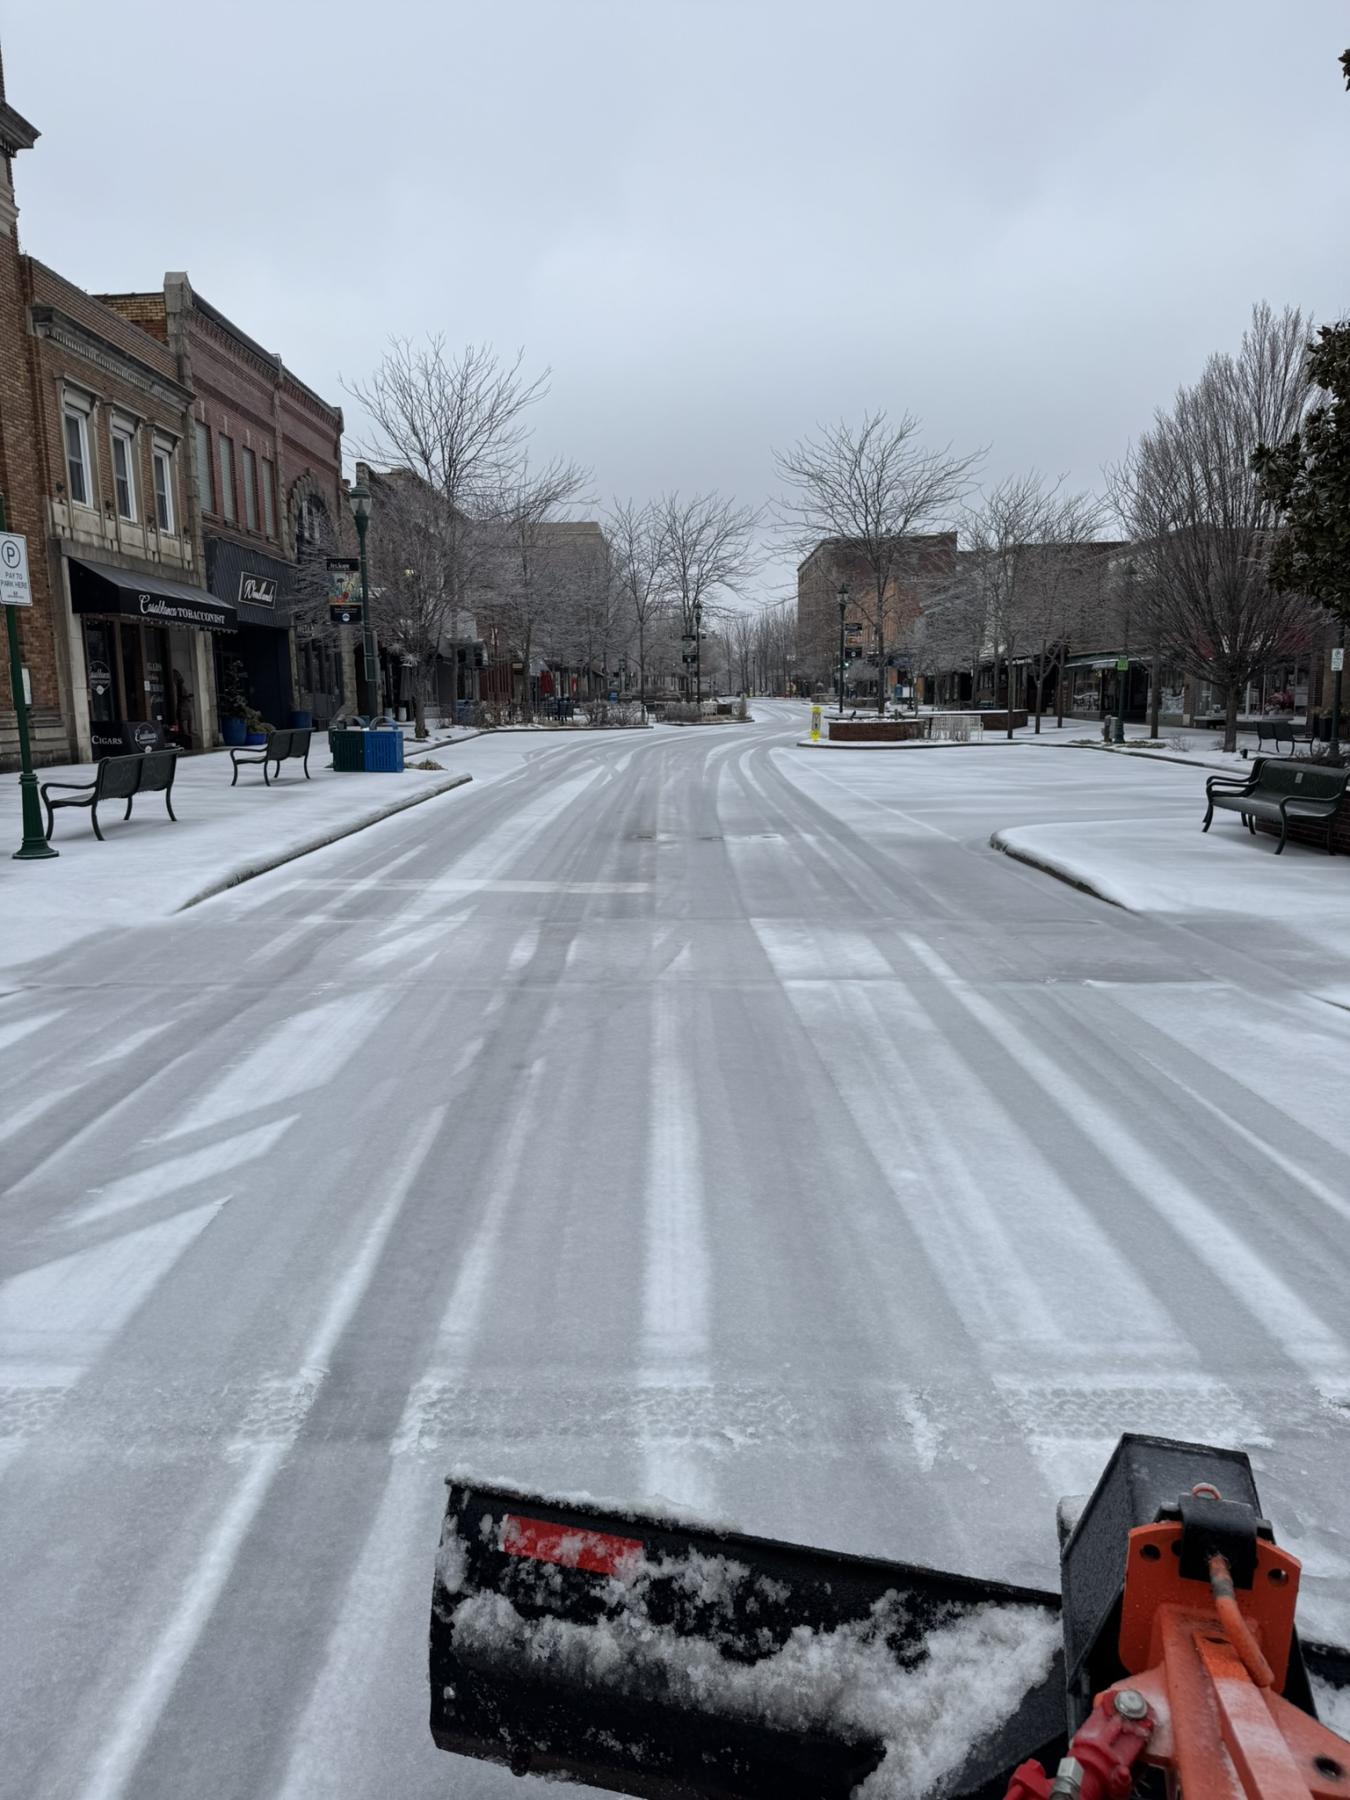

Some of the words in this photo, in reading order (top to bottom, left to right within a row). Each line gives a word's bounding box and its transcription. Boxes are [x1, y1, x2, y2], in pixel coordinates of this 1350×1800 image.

[6, 546, 15, 563] P
[5, 571, 15, 579] PAY
[177, 607, 225, 625] TOBACCONIST
